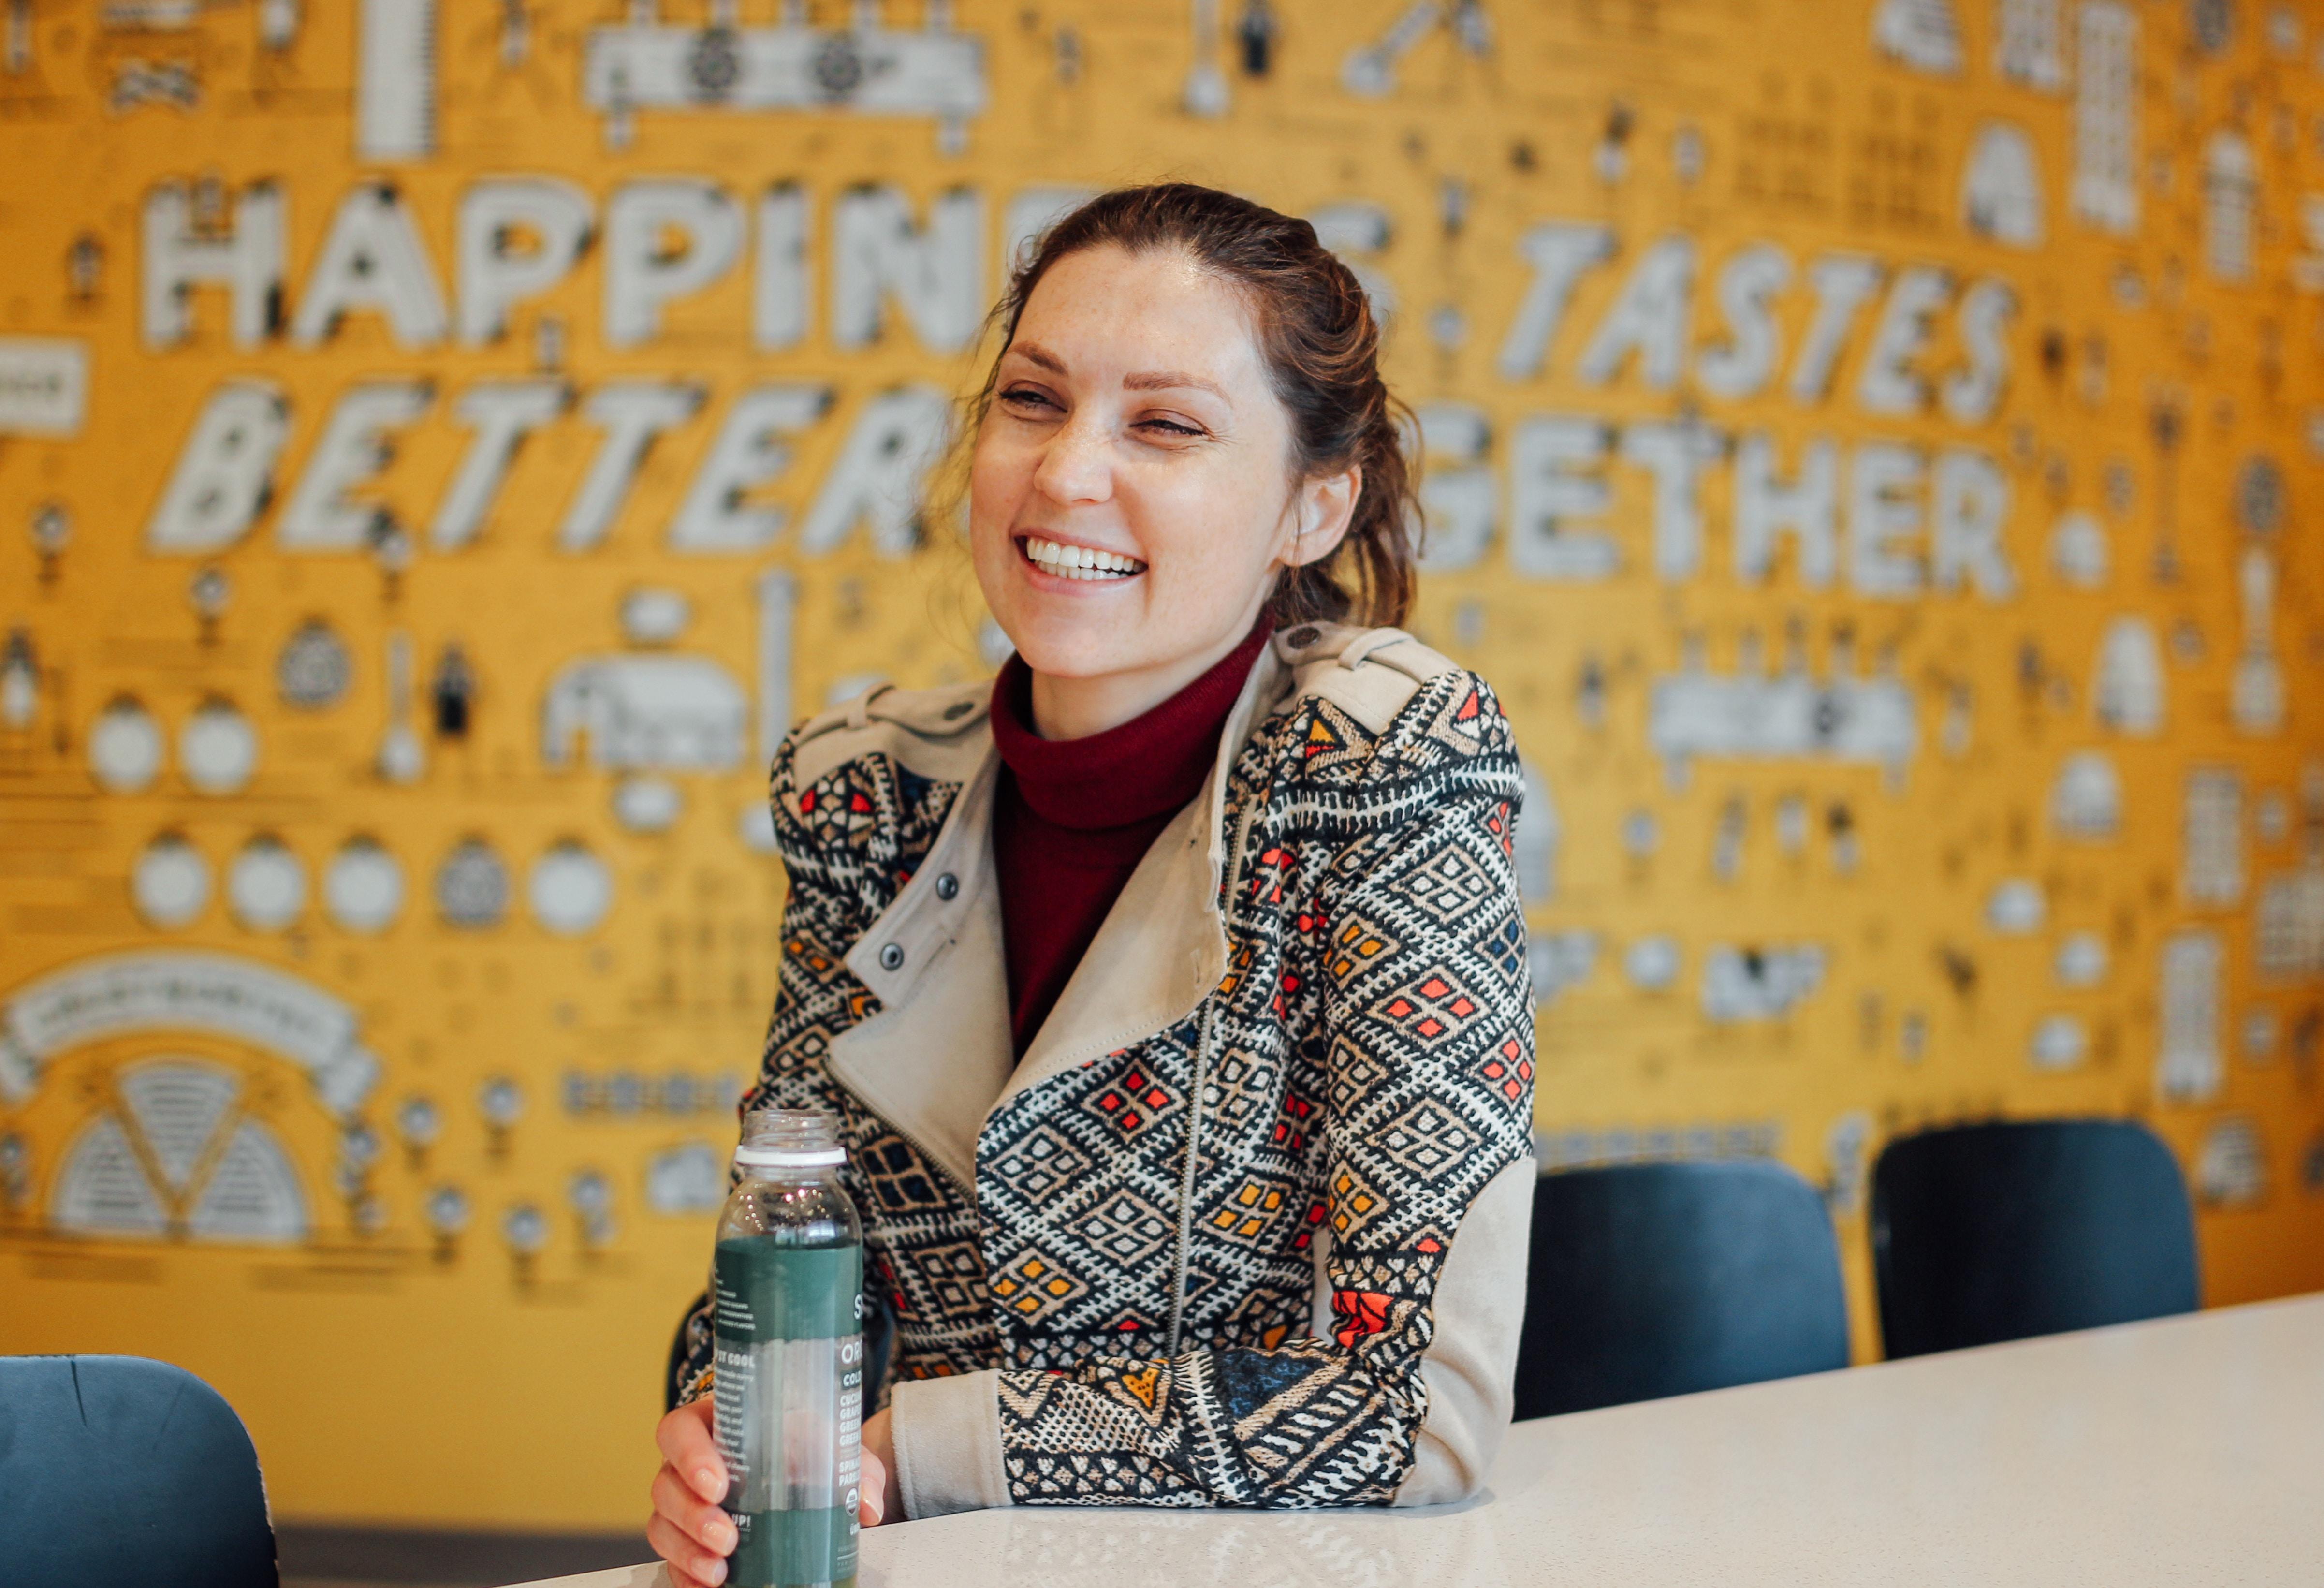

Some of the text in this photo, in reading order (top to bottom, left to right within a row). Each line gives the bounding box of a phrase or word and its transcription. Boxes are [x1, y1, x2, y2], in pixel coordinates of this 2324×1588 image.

[139, 177, 2016, 422] HAPPIN TASTES
[147, 379, 2017, 602] BETTER GETHER
[728, 1353, 755, 1369] COOL
